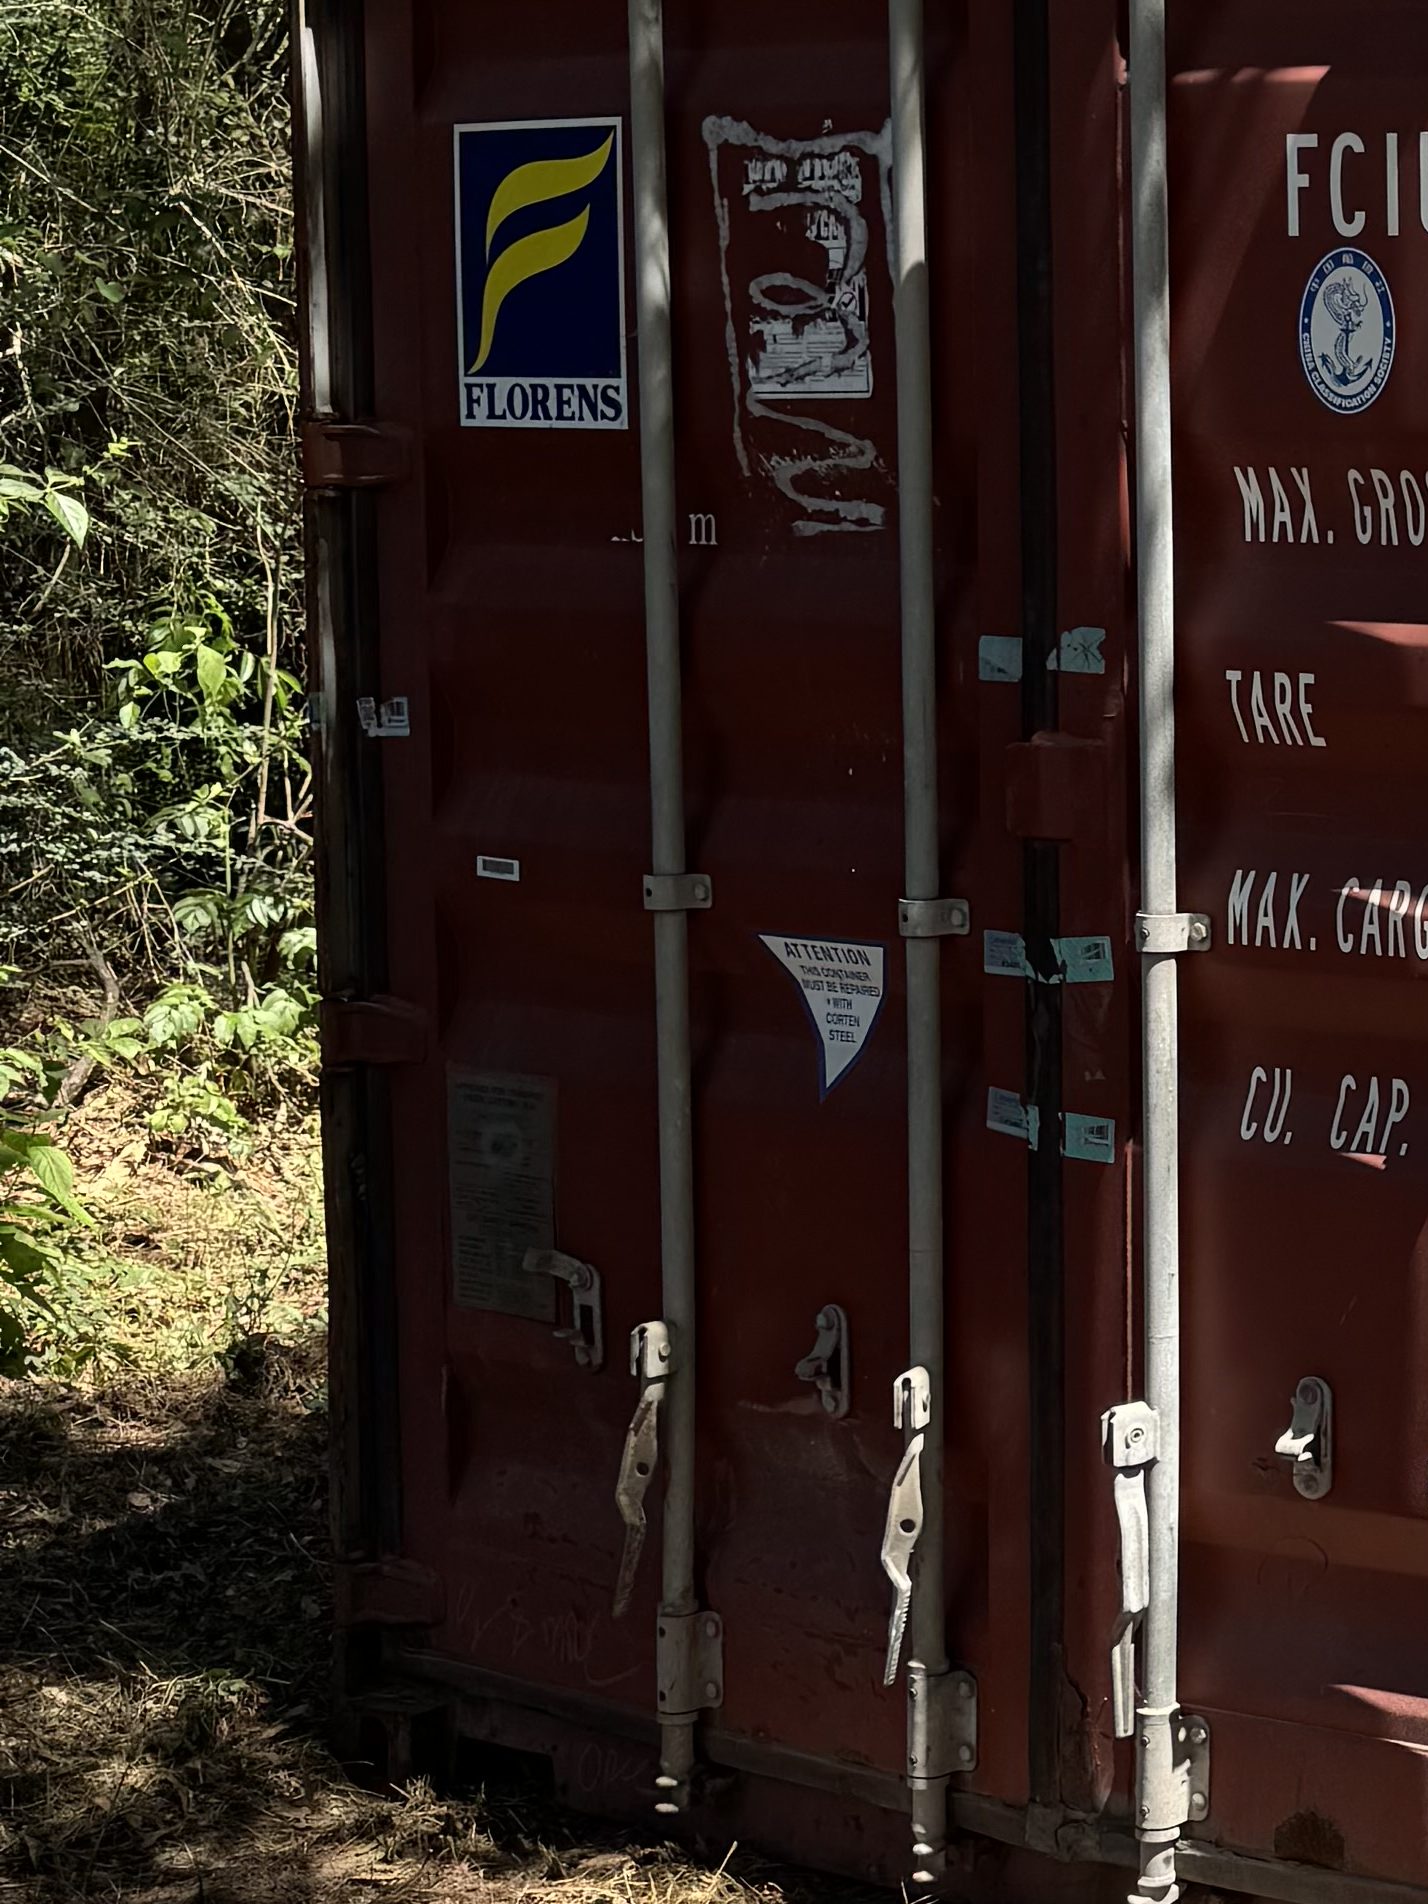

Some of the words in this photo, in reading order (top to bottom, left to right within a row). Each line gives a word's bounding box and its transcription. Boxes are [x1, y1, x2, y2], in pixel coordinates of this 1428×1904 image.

[463, 382, 623, 423] FLORENS
[1233, 466, 1334, 544] MAX.
[1225, 669, 1327, 747] TARE
[1227, 869, 1316, 951] MAX.
[784, 941, 872, 967] ATTENTION
[800, 964, 821, 978] THIS
[821, 966, 872, 982] CONTAINER
[802, 979, 825, 992] MUST
[826, 981, 839, 993] BE
[840, 983, 881, 998] REPAIRED
[832, 998, 853, 1010] WITH
[826, 1012, 860, 1027] CORTEN
[829, 1029, 857, 1043] STEEL
[1240, 1066, 1293, 1145] CU.
[1330, 1074, 1410, 1158] CAP.
